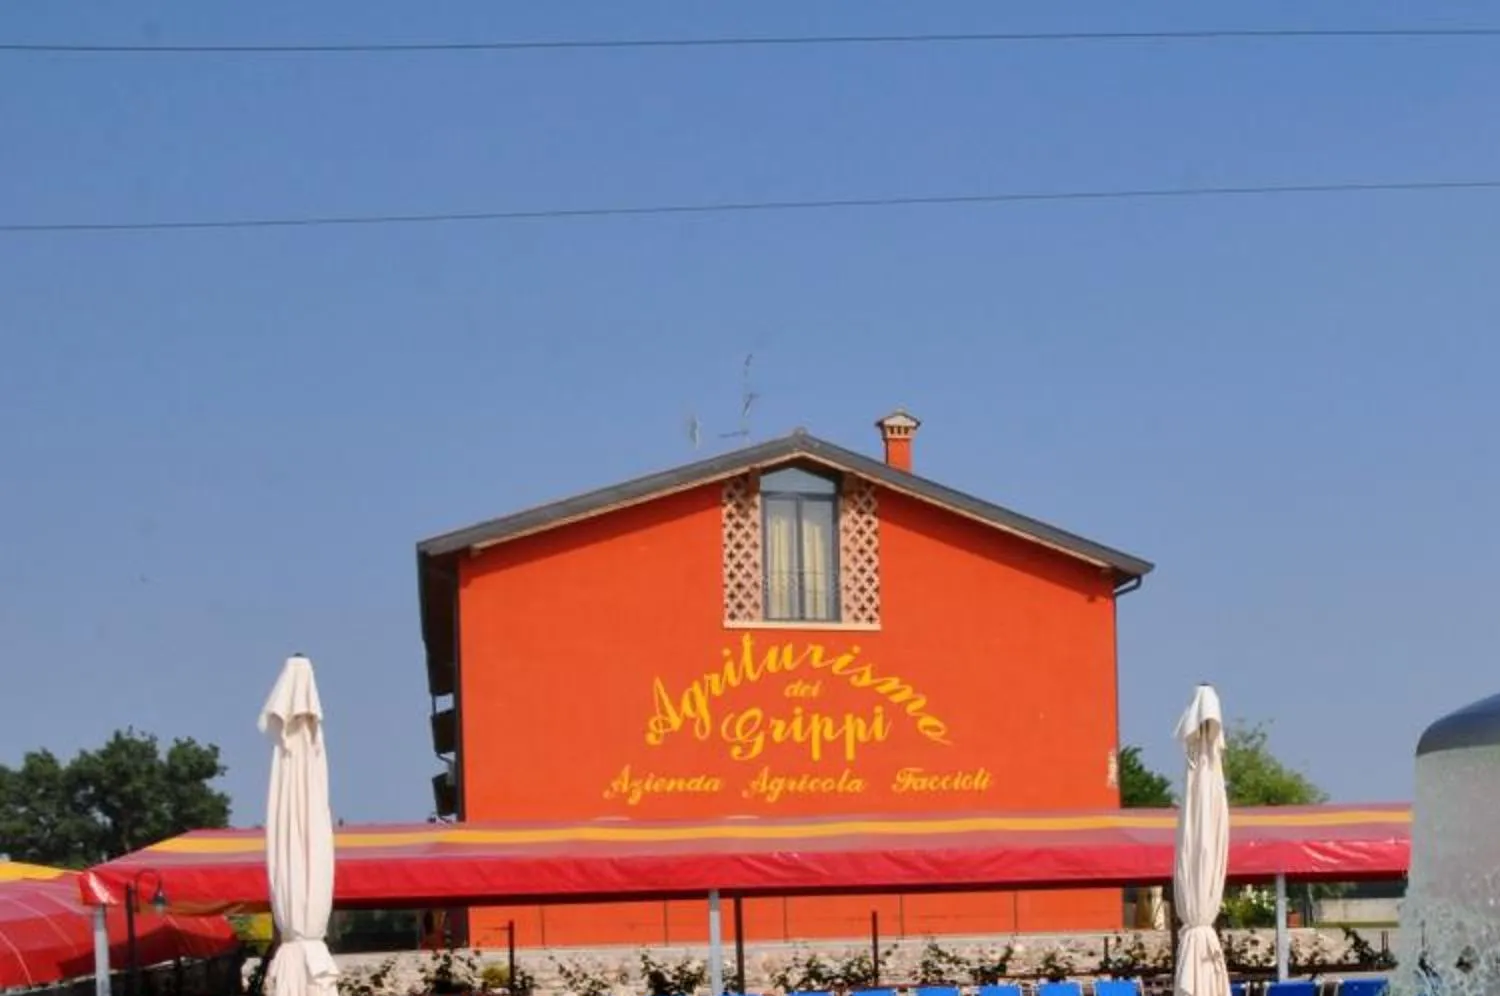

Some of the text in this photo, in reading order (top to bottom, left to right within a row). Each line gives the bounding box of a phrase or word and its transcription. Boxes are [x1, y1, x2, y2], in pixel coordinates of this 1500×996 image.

[645, 632, 952, 746] Agriturismo
[721, 705, 892, 760] Grippi
[602, 764, 992, 805] Azienda Agricola Faccioli
